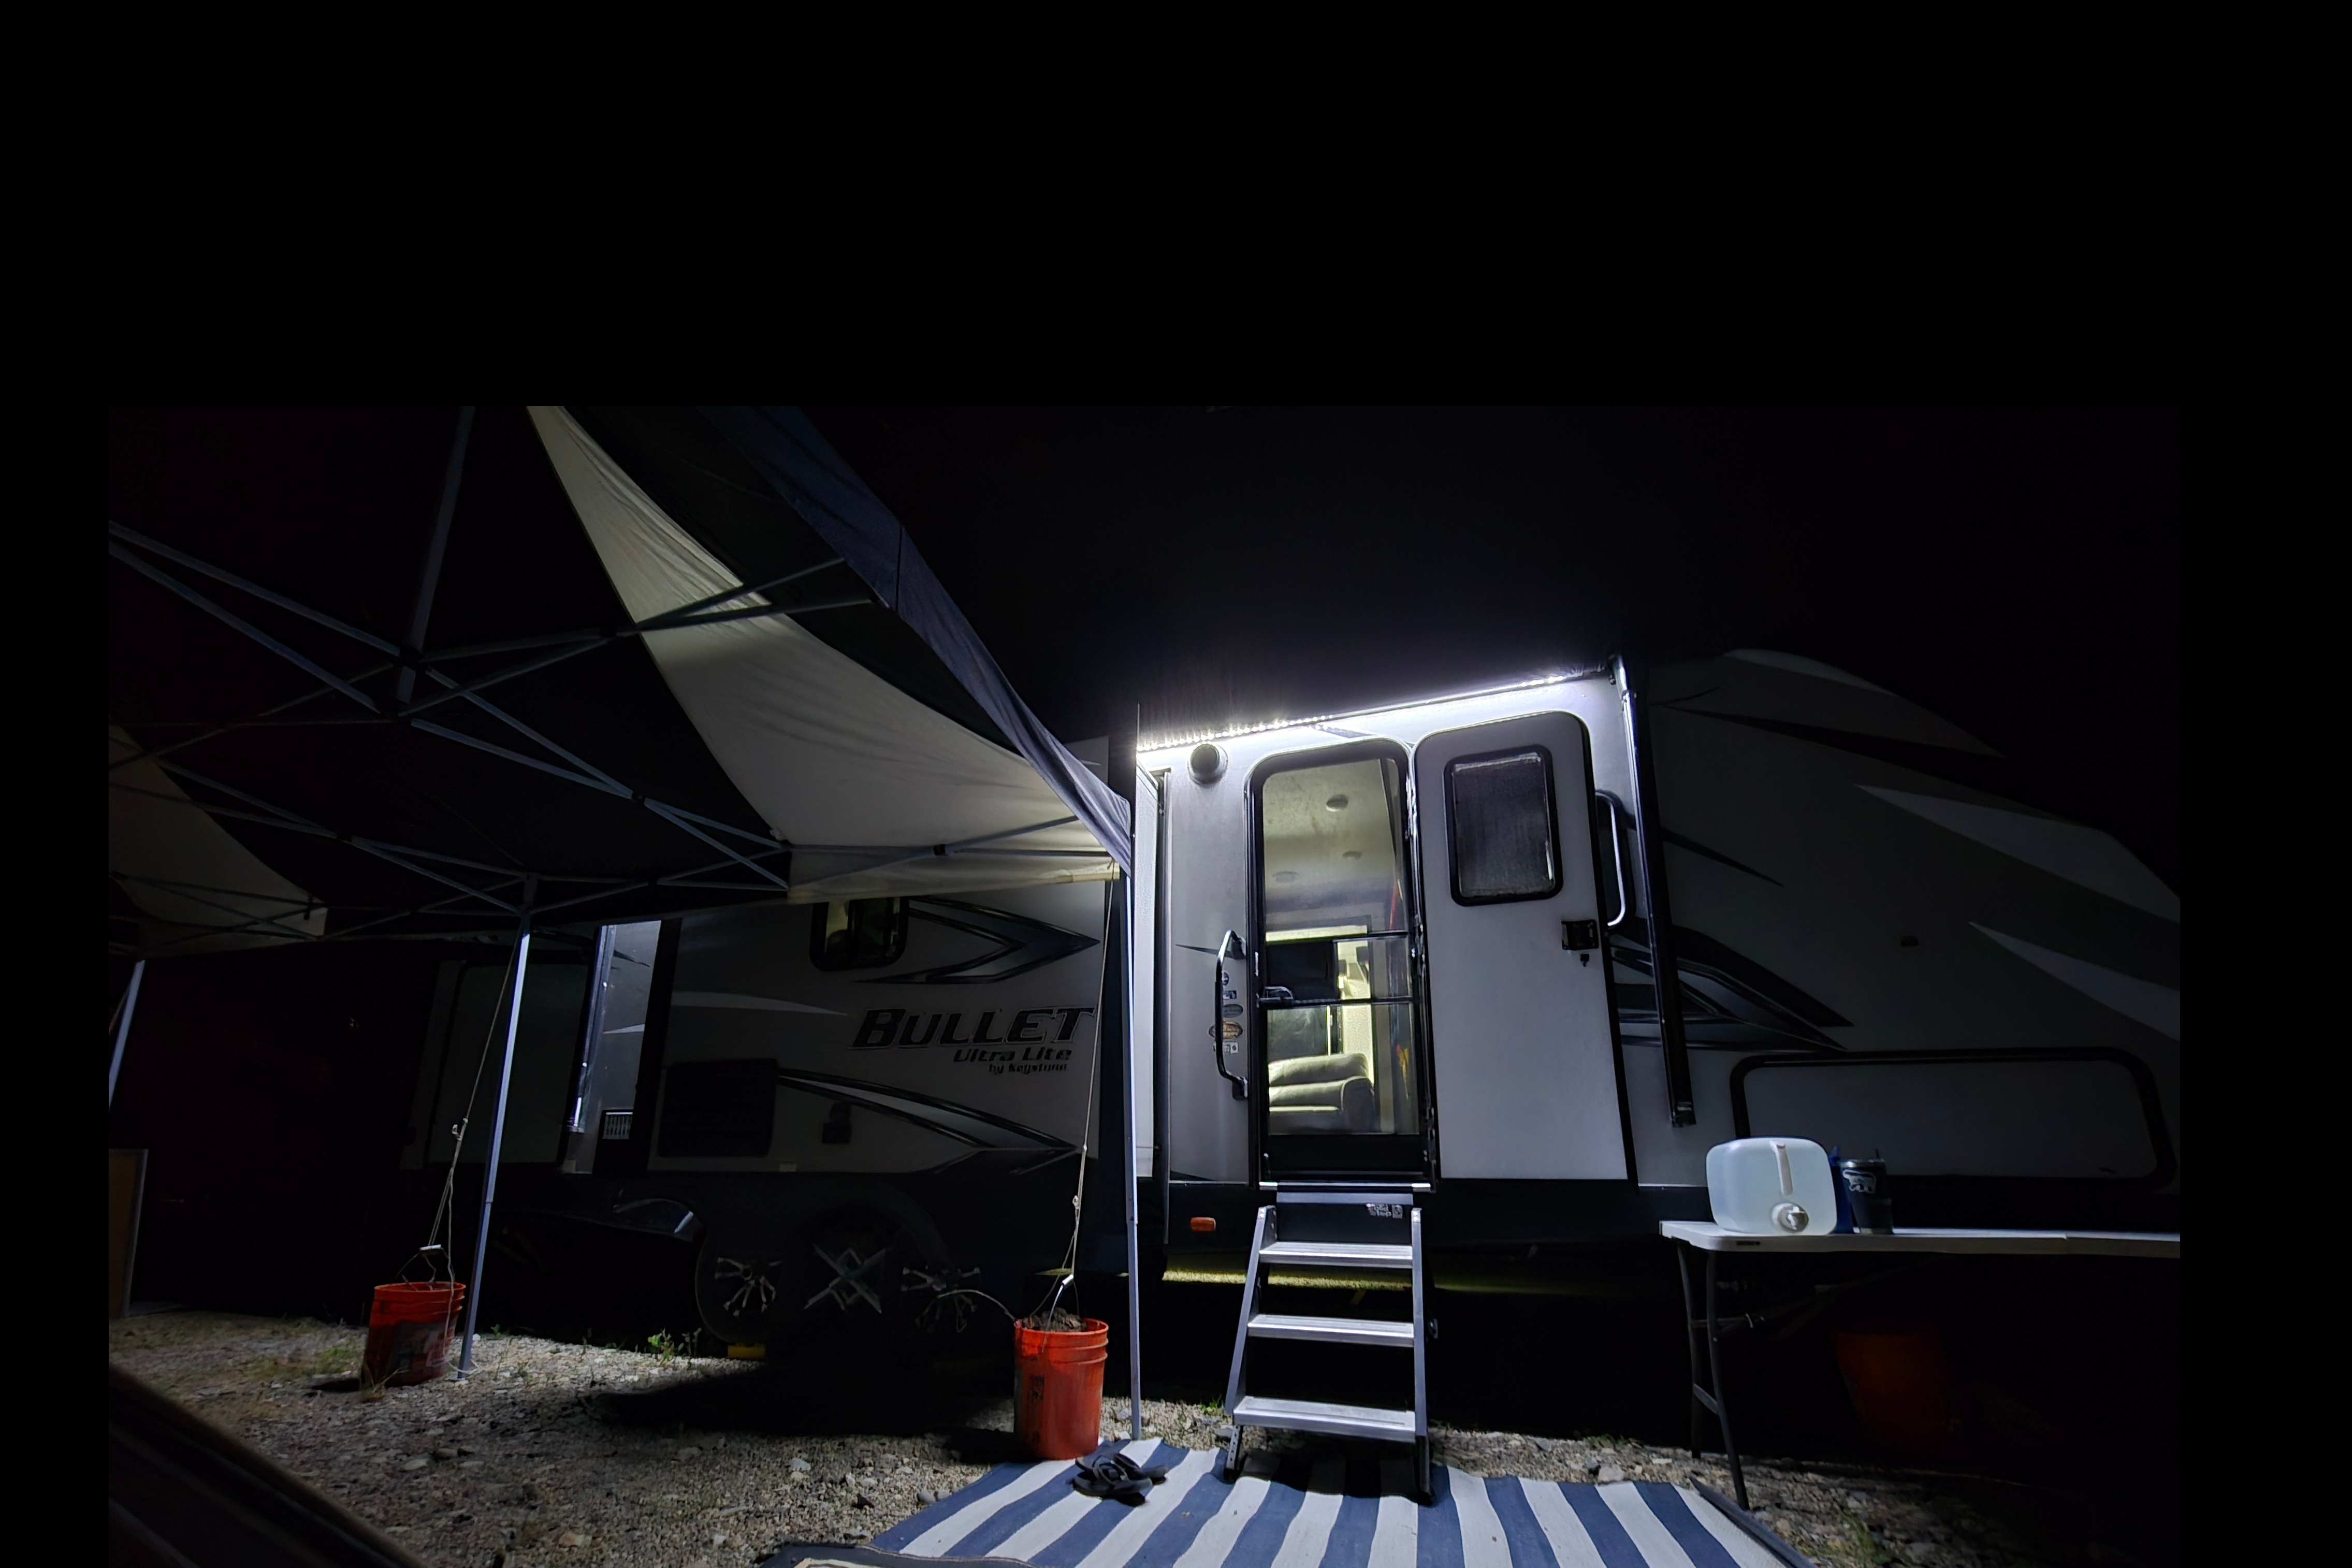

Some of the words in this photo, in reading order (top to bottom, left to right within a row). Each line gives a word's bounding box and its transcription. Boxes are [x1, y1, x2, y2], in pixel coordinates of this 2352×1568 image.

[850, 1006, 1096, 1049] BULLET
[953, 1048, 1015, 1062] Ultra
[1022, 1047, 1072, 1061] Lite
